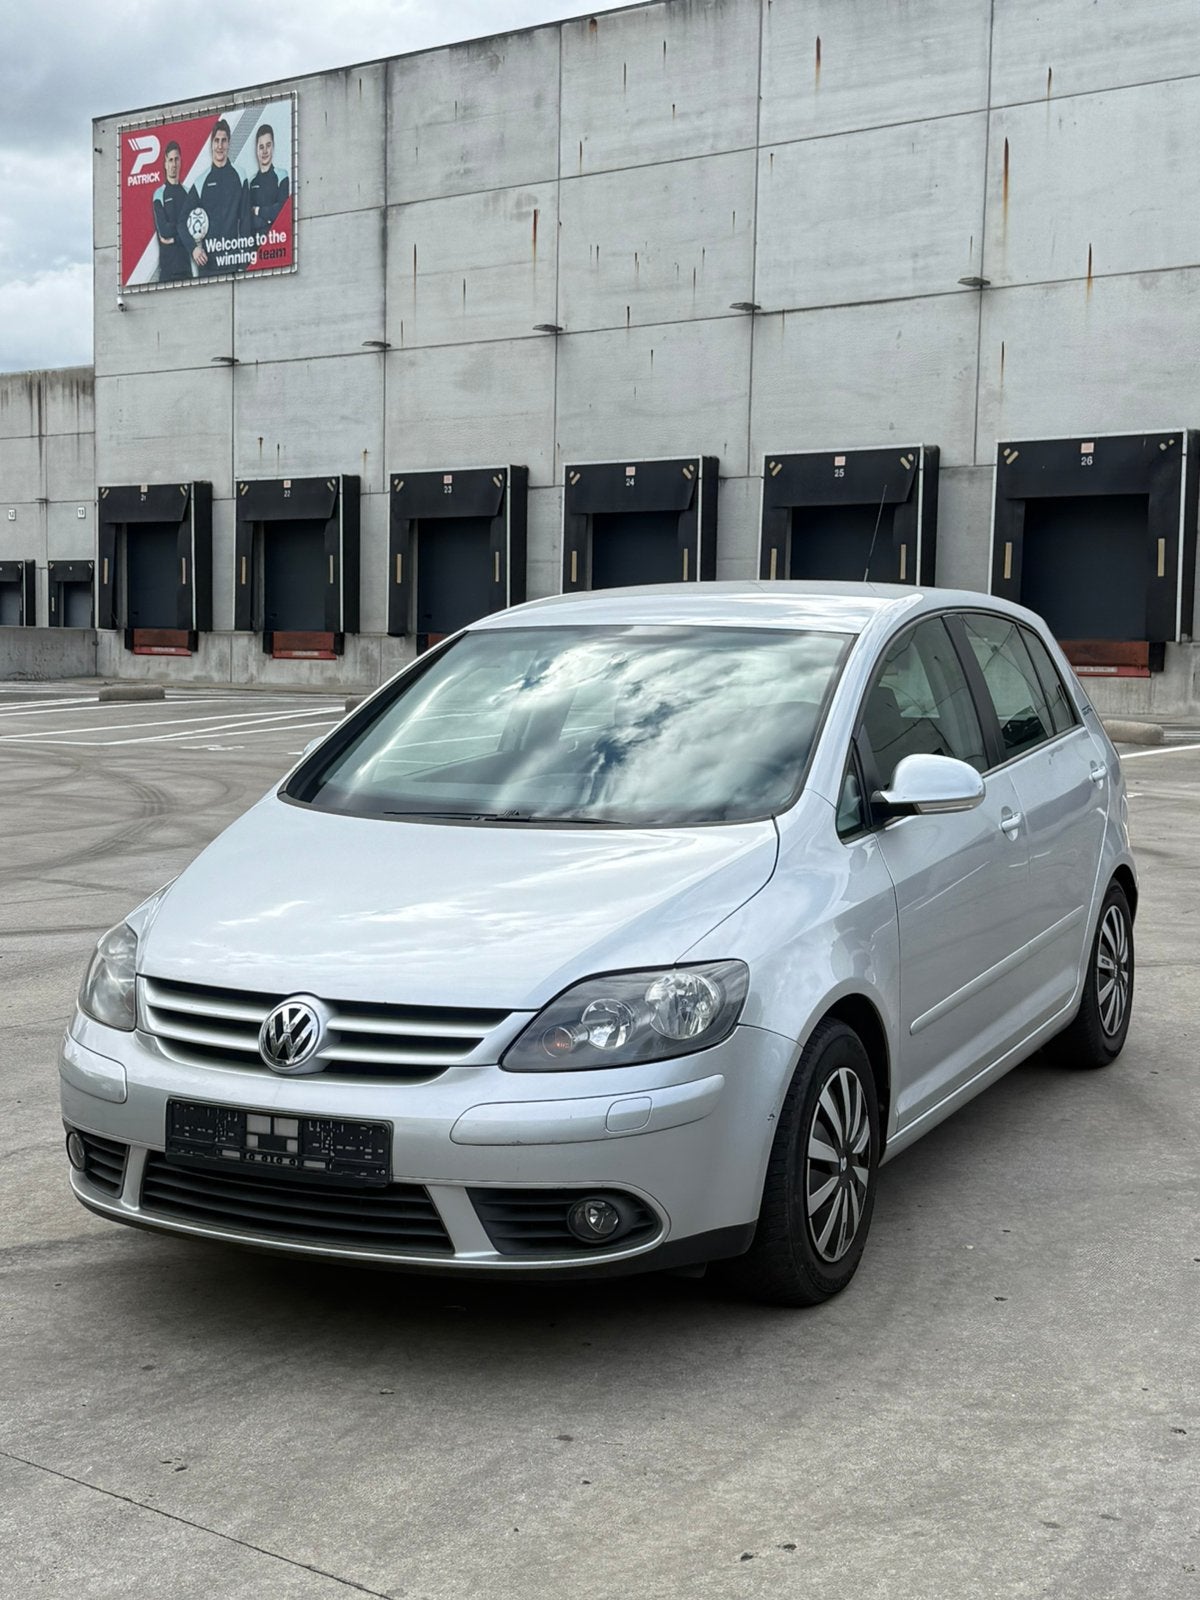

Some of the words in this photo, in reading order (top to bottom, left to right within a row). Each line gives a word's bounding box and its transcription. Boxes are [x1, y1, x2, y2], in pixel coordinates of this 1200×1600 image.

[127, 171, 160, 187] PATRICK
[205, 236, 255, 253] Welcome
[255, 232, 267, 246] to
[268, 229, 287, 244] the
[216, 249, 257, 266] winning
[258, 247, 286, 260] team
[1081, 456, 1093, 465] 26
[834, 468, 845, 477] 25
[625, 478, 635, 487] 24
[284, 490, 291, 498] 22
[444, 485, 452, 494] 23
[263, 1003, 318, 1066] VW
